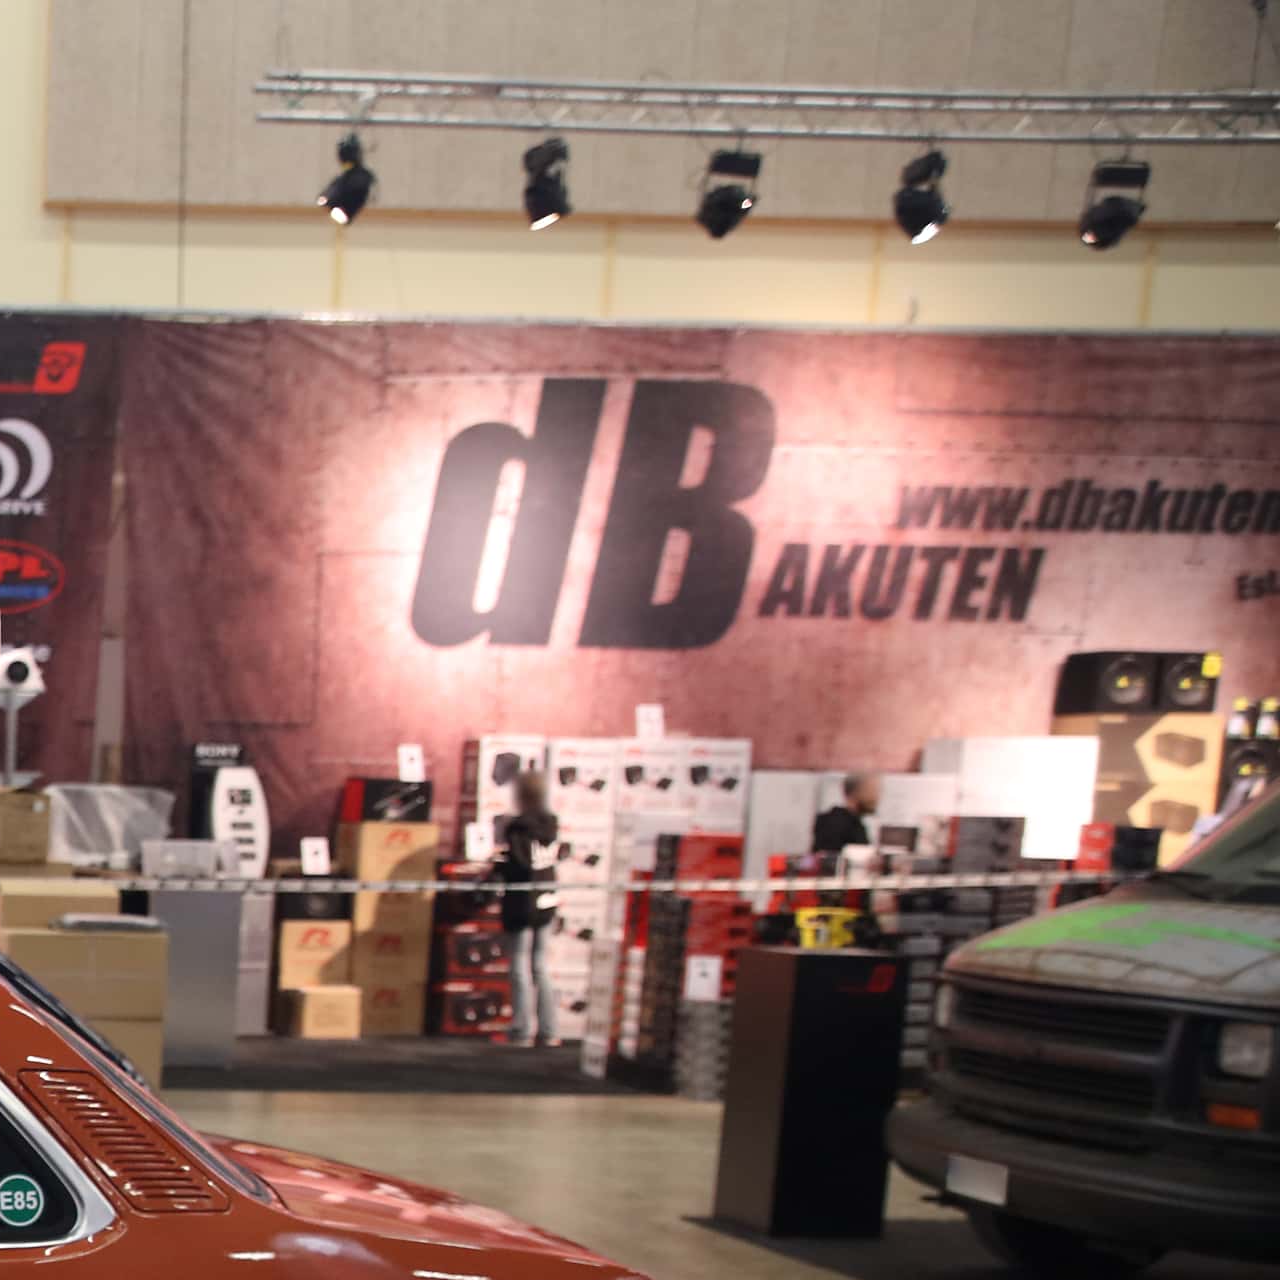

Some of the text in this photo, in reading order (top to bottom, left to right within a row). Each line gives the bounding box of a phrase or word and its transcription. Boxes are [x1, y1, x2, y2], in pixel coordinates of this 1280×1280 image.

[410, 379, 1046, 648] dB AKUTEN
[0, 1191, 38, 1211] E85
